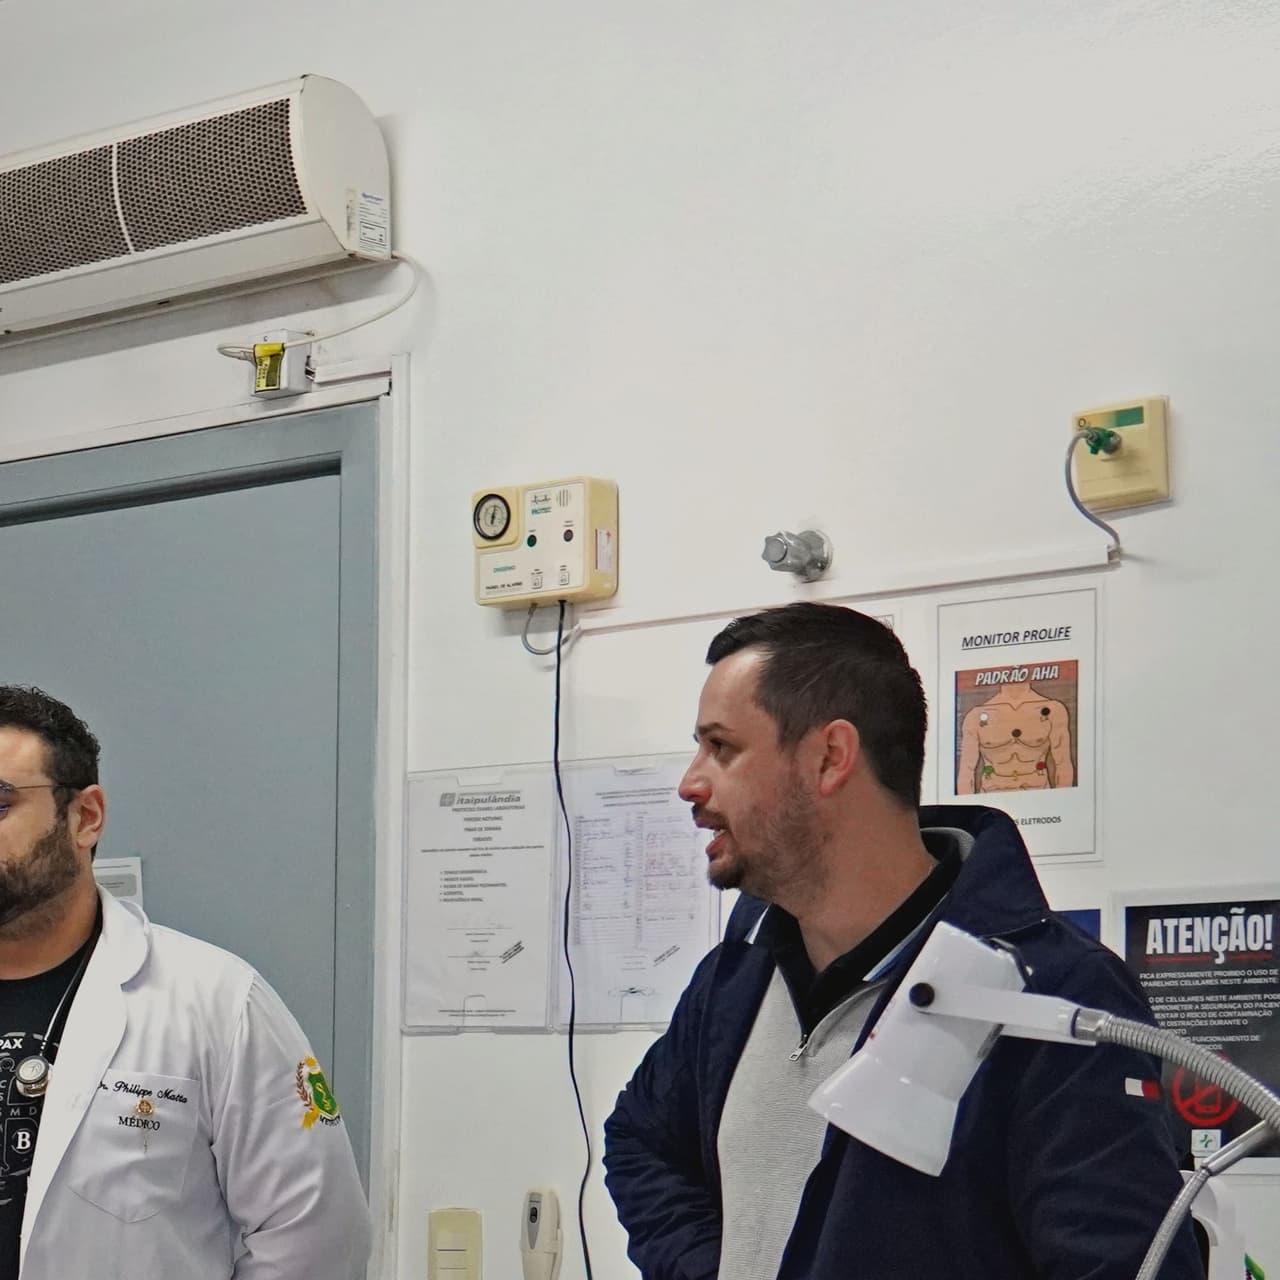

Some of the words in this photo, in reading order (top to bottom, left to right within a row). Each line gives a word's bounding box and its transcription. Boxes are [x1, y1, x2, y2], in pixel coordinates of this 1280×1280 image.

[961, 631, 1019, 649] MONITOR
[1024, 626, 1072, 642] PROLIFE
[975, 664, 1028, 686] PADRÃO
[1031, 665, 1059, 681] AHA
[1020, 816, 1062, 826] ELETRODOS
[1145, 907, 1274, 965] ATENÇÃO!
[1156, 971, 1212, 979] EXPRESSAMENTE
[1179, 979, 1219, 987] CELULARES
[1165, 995, 1204, 1003] CELULARES
[1205, 994, 1227, 1002] NESTE
[1228, 993, 1262, 1001] AMBIENTE
[1254, 1001, 1280, 1009] PACIENT
[1218, 1009, 1273, 1018] CONTAMINAÇÃO
[1192, 1034, 1250, 1042] FUNCIONAMENTO
[118, 1115, 161, 1132] MÉDICO
